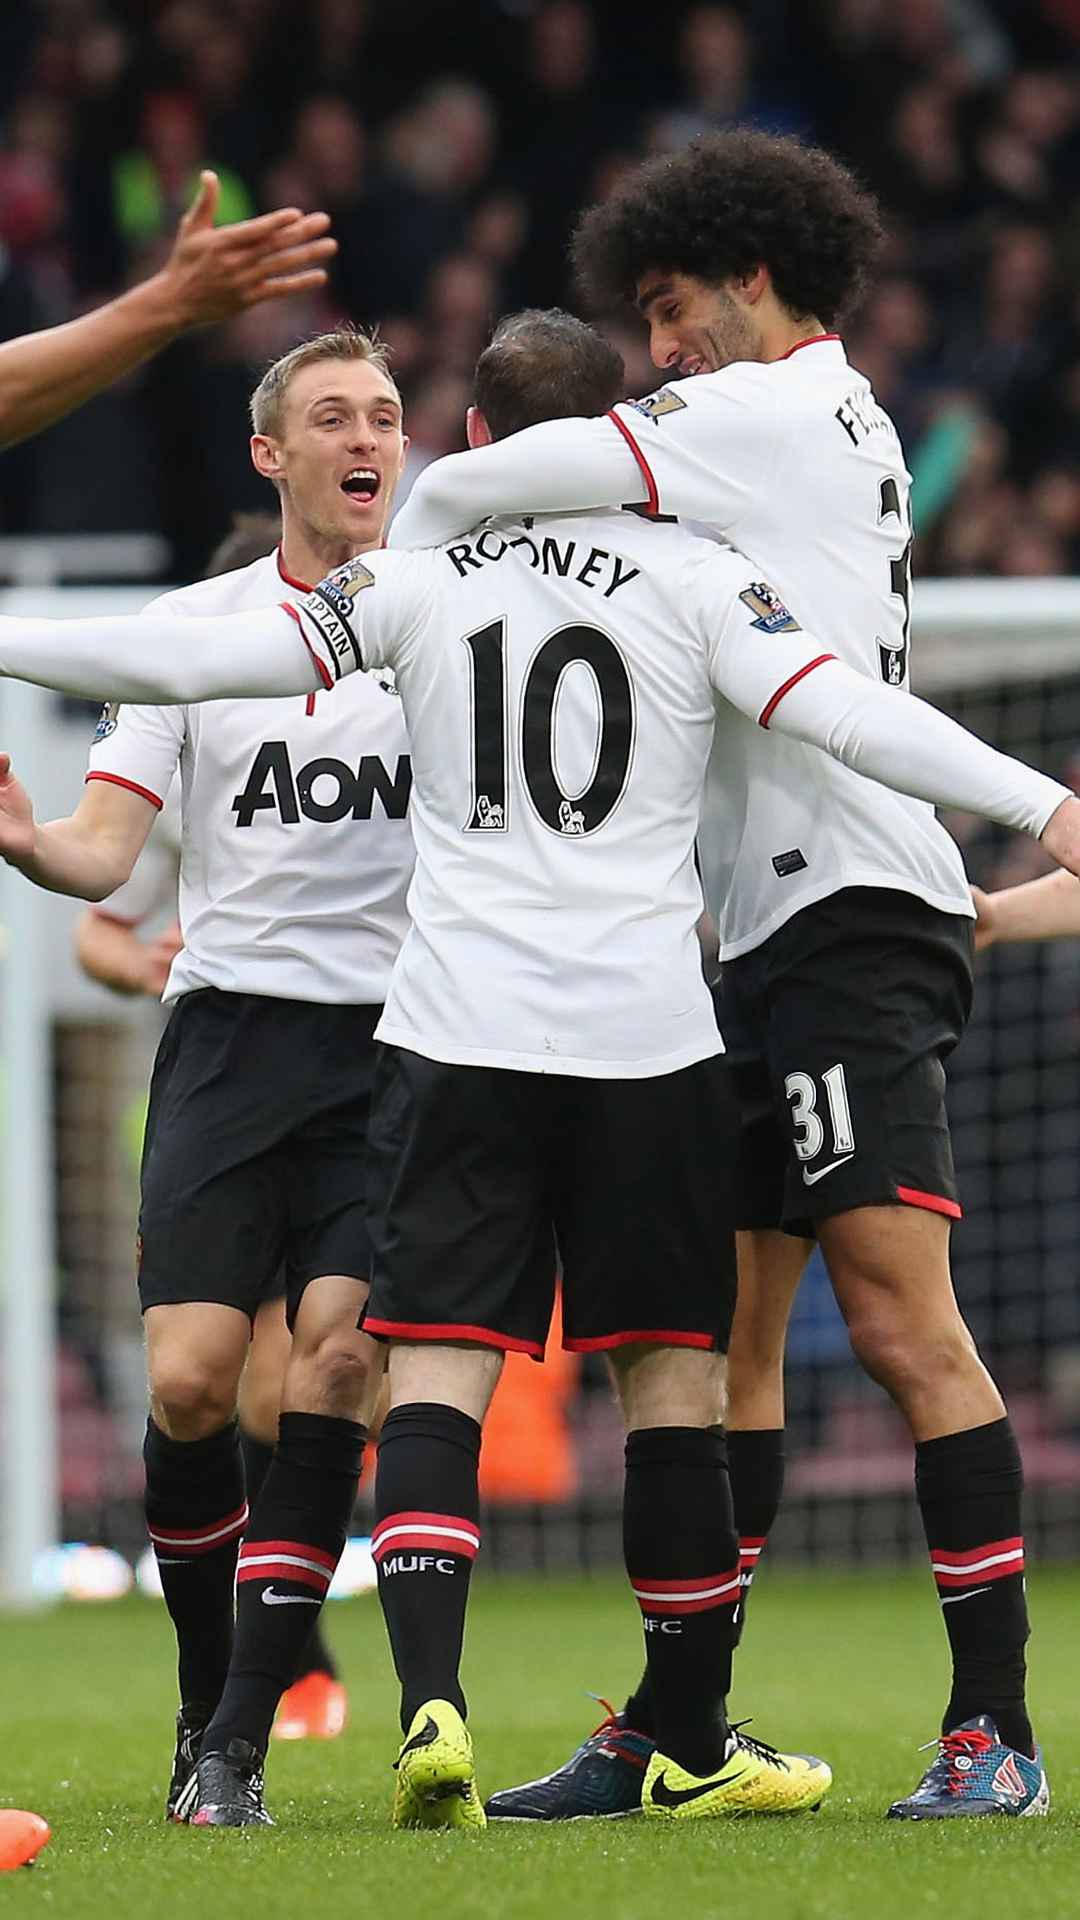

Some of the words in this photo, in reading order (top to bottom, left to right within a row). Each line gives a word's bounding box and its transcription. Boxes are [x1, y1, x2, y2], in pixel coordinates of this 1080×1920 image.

[305, 596, 351, 656] APTAIN
[461, 614, 637, 839] 10
[231, 740, 413, 828] AON
[784, 1063, 855, 1161] 31
[382, 1555, 455, 1577] MUFC
